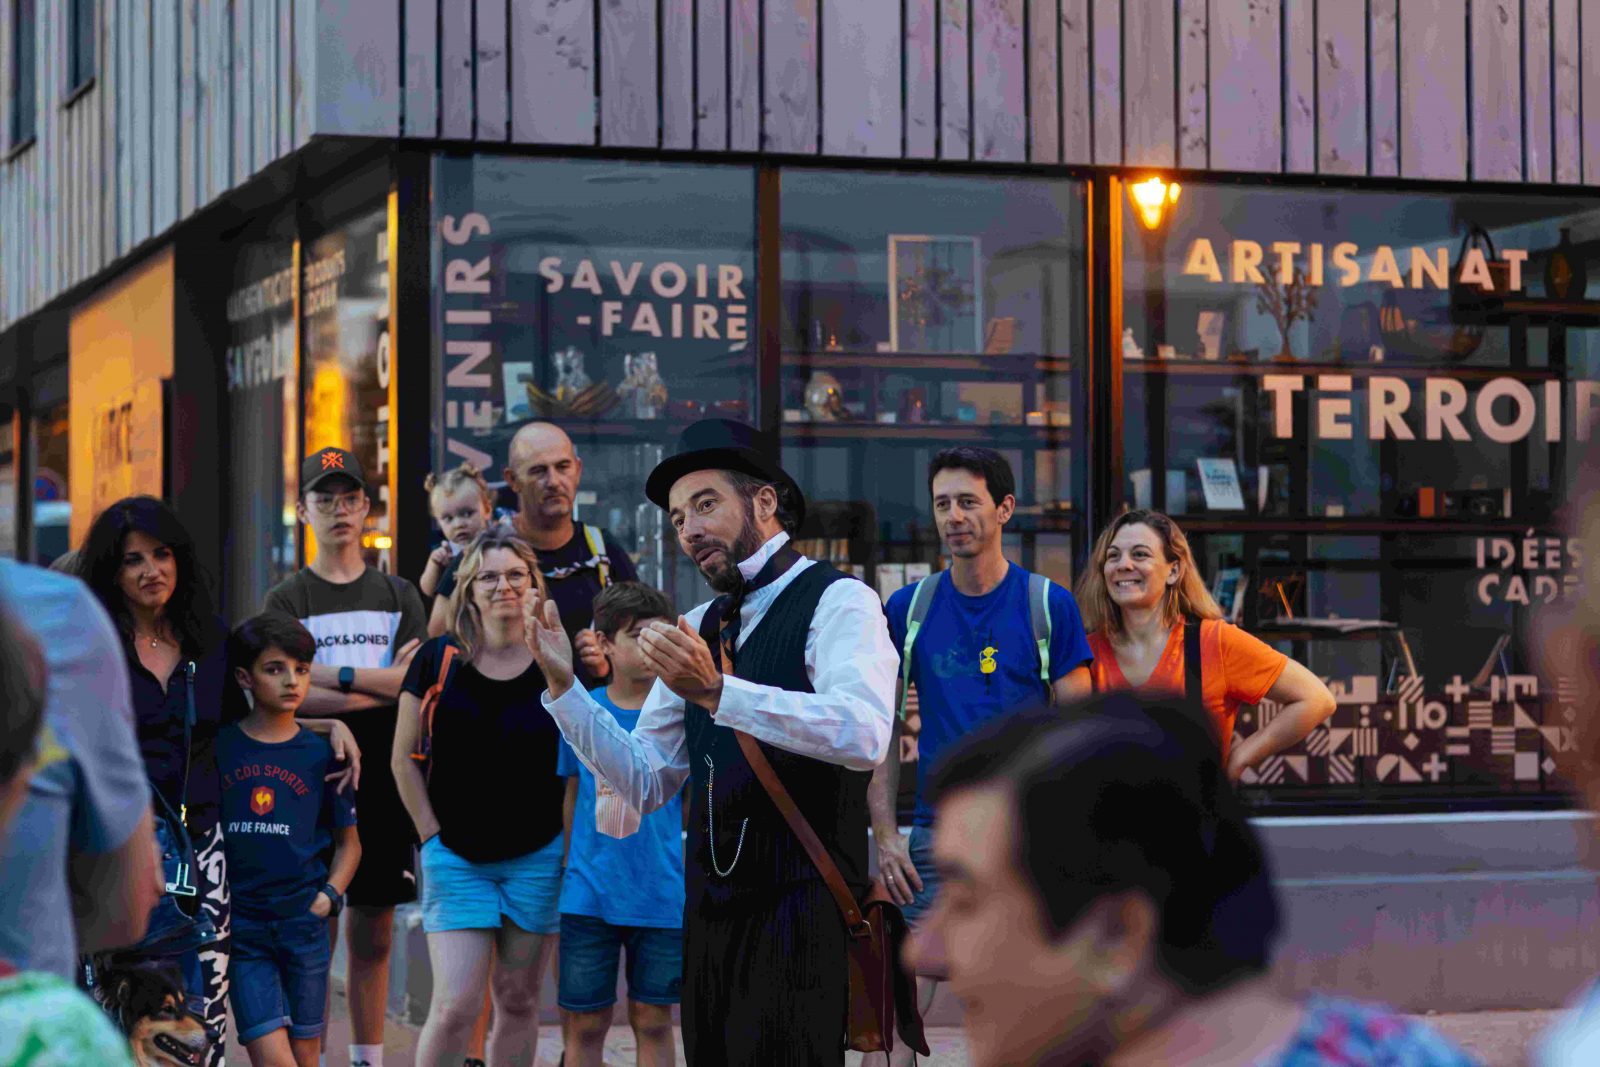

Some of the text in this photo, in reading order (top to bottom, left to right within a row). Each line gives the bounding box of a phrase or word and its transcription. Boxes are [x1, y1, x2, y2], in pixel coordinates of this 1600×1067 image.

[538, 257, 746, 299] SAVOIR
[1184, 238, 1529, 291] ARTISANAT
[228, 821, 290, 836] XV DE FRANCE
